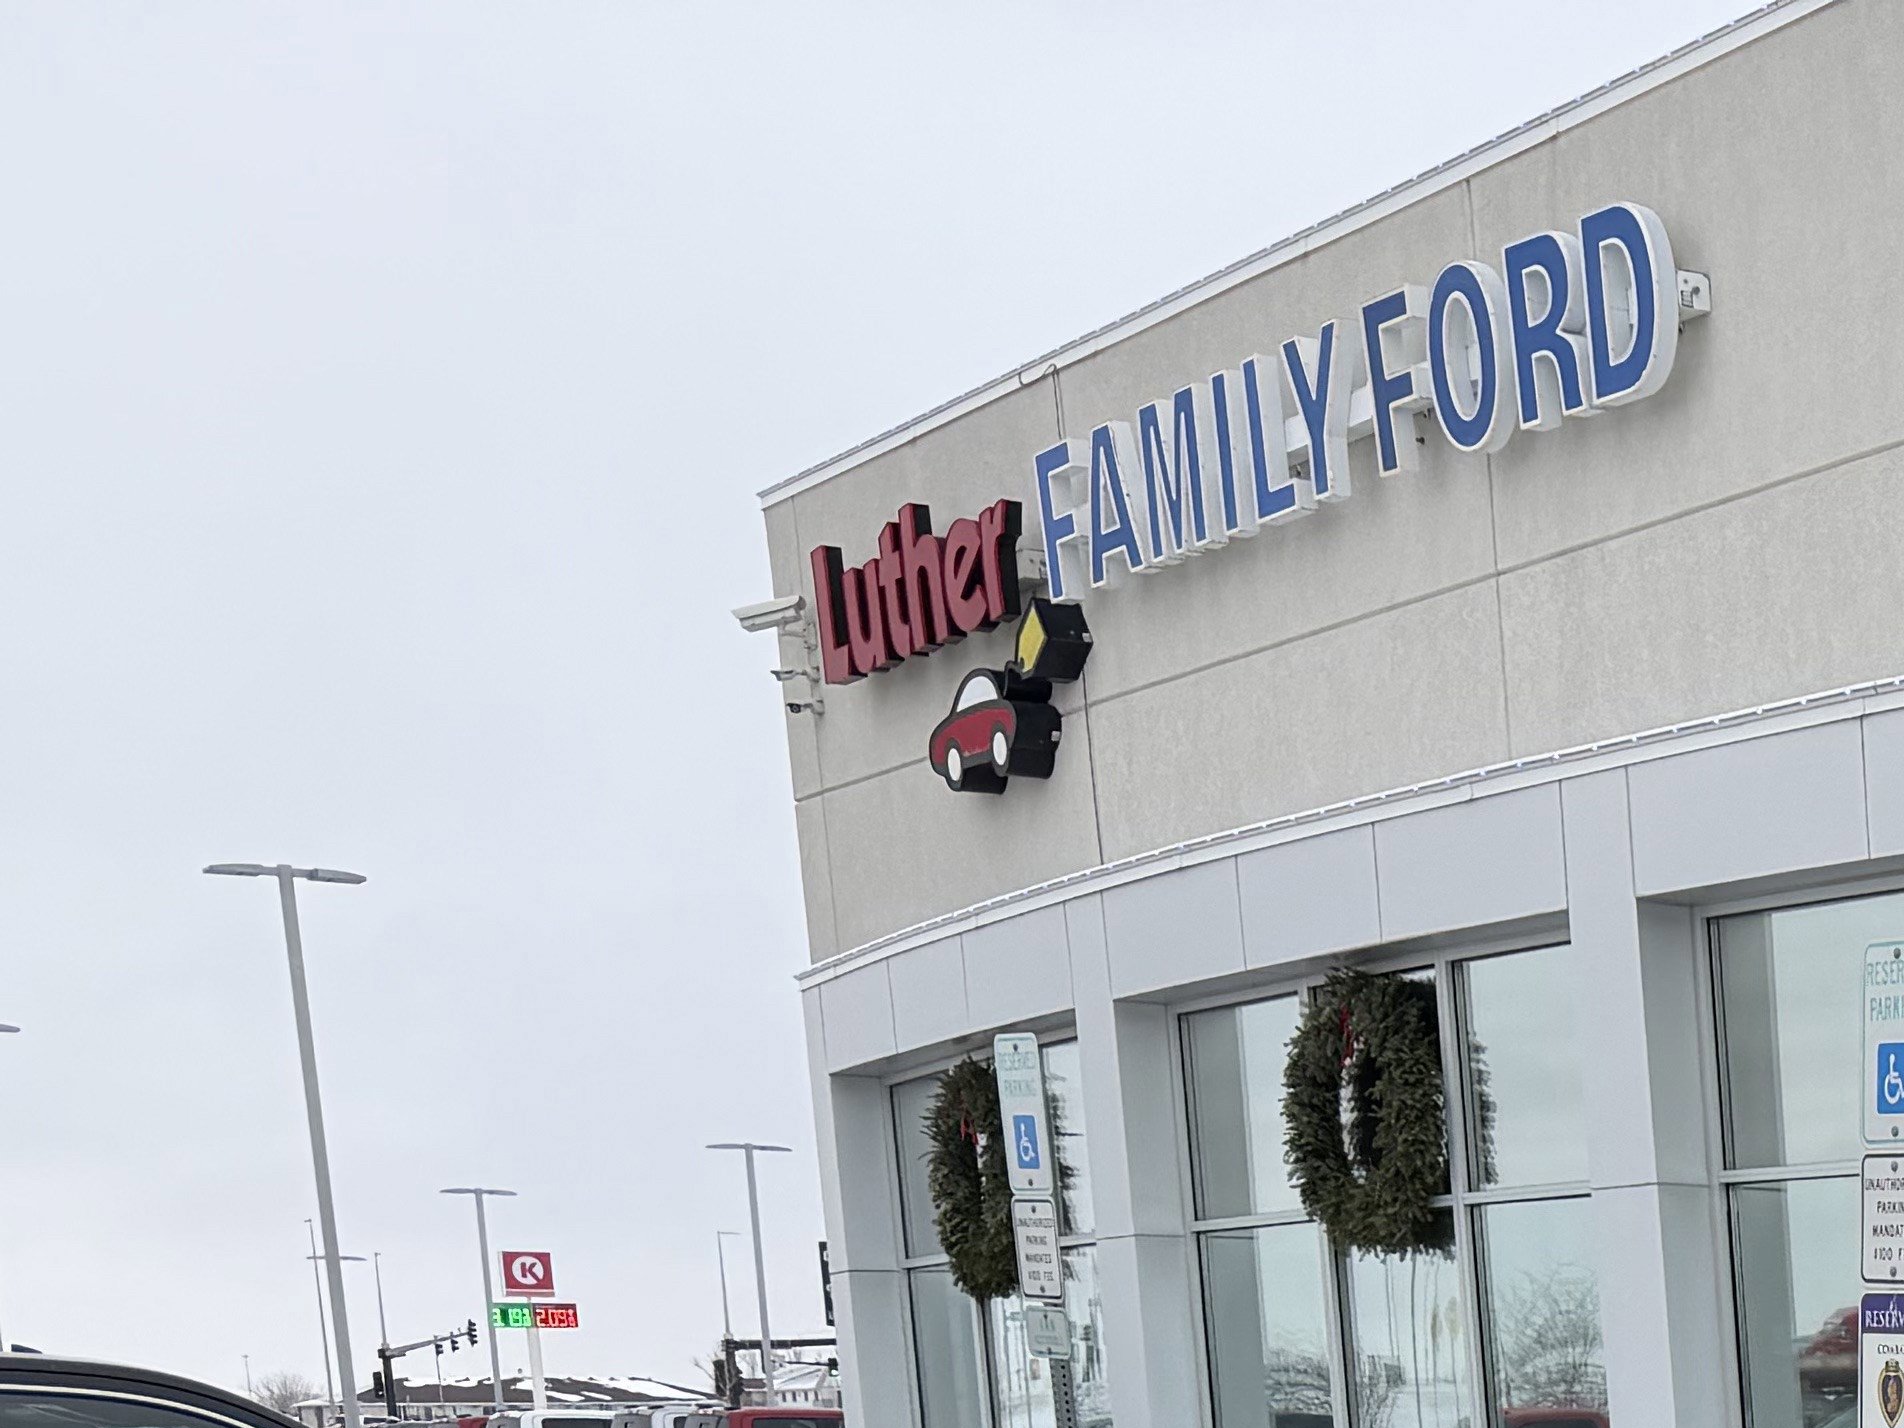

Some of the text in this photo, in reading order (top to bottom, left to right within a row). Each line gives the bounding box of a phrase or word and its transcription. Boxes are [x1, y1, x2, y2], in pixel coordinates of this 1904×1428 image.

[1033, 201, 1678, 603] FAMILY FORD
[811, 498, 1022, 684] Luther
